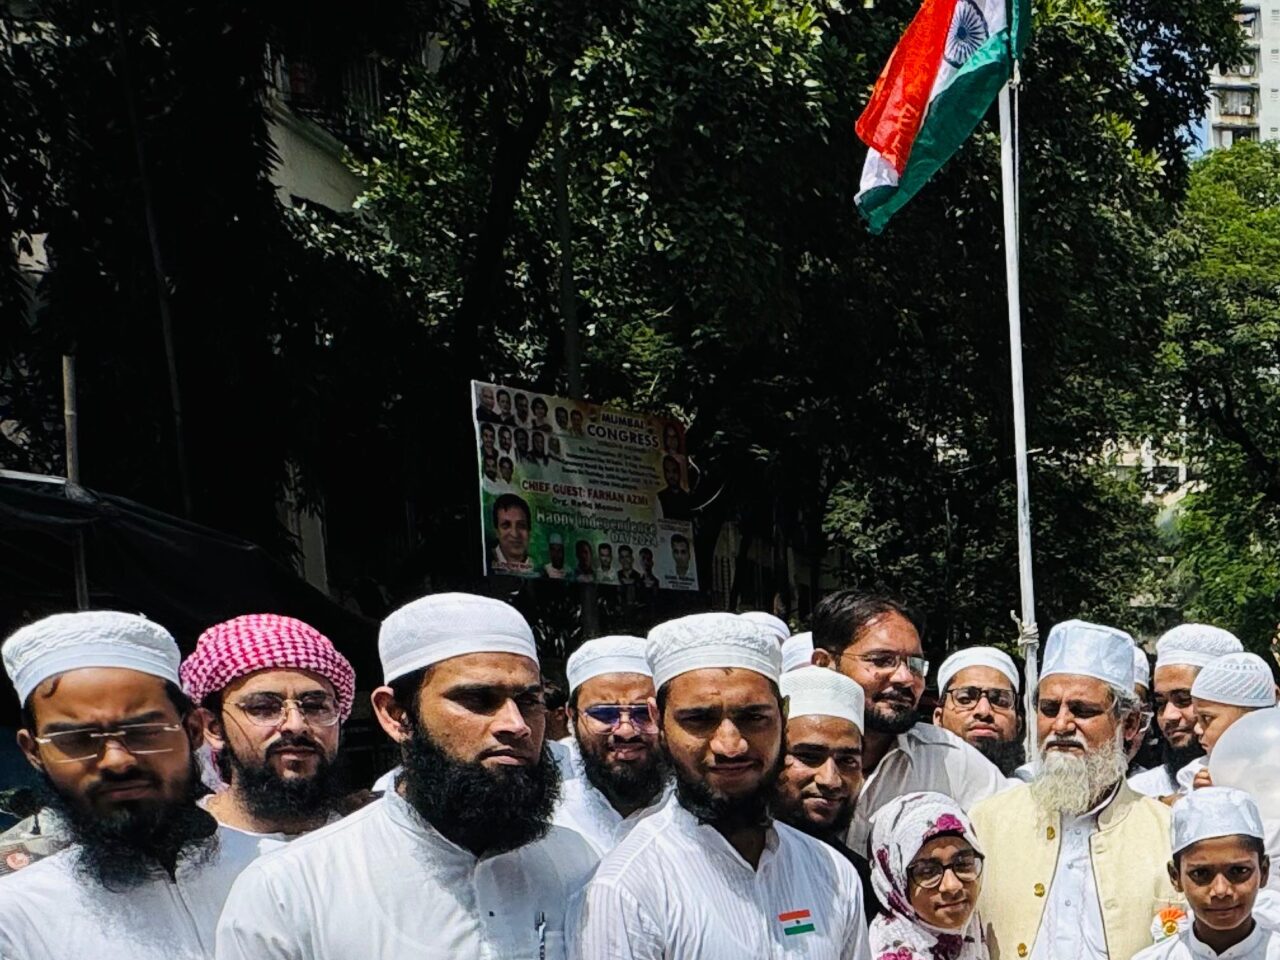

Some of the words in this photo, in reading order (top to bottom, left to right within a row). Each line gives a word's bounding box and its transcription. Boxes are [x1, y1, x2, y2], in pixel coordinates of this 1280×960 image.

[601, 413, 644, 429] MUMBAI
[587, 424, 659, 448] CONGRESS
[522, 480, 551, 492] CHIEF
[553, 484, 585, 497] GUEST:
[587, 488, 626, 503] FARHAN
[536, 507, 576, 529] Happy
[611, 529, 631, 544] DAY
